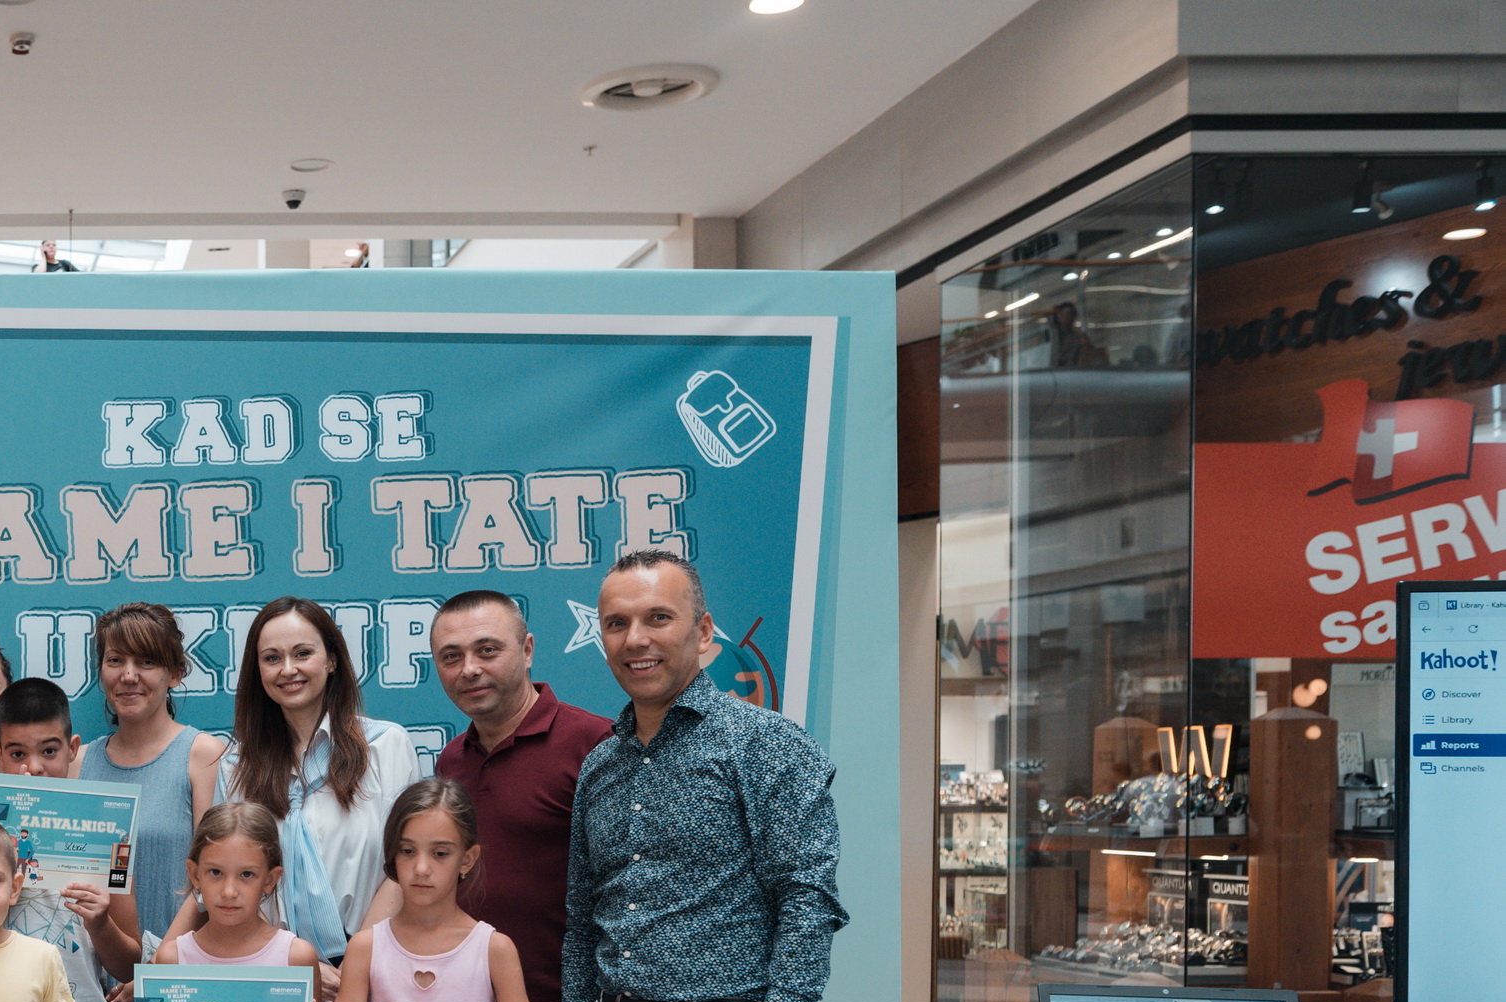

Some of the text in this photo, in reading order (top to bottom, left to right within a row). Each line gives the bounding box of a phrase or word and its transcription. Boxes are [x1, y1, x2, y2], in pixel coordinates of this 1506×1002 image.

[1196, 255, 1482, 370] watches &
[102, 392, 430, 470] KAD SE
[292, 475, 343, 578] I
[370, 467, 694, 575] TATE
[1460, 602, 1484, 610] Library
[1320, 600, 1396, 654] sa
[16, 608, 98, 701] U
[1421, 648, 1498, 671] Kahoot!
[1442, 691, 1481, 699] Discover
[1442, 716, 1473, 725] Library
[1441, 741, 1479, 750] Reports
[1441, 765, 1484, 773] Channels
[103, 800, 131, 808] memento
[19, 814, 116, 834] ZAHVALNICU
[1212, 881, 1249, 896] QUANTU
